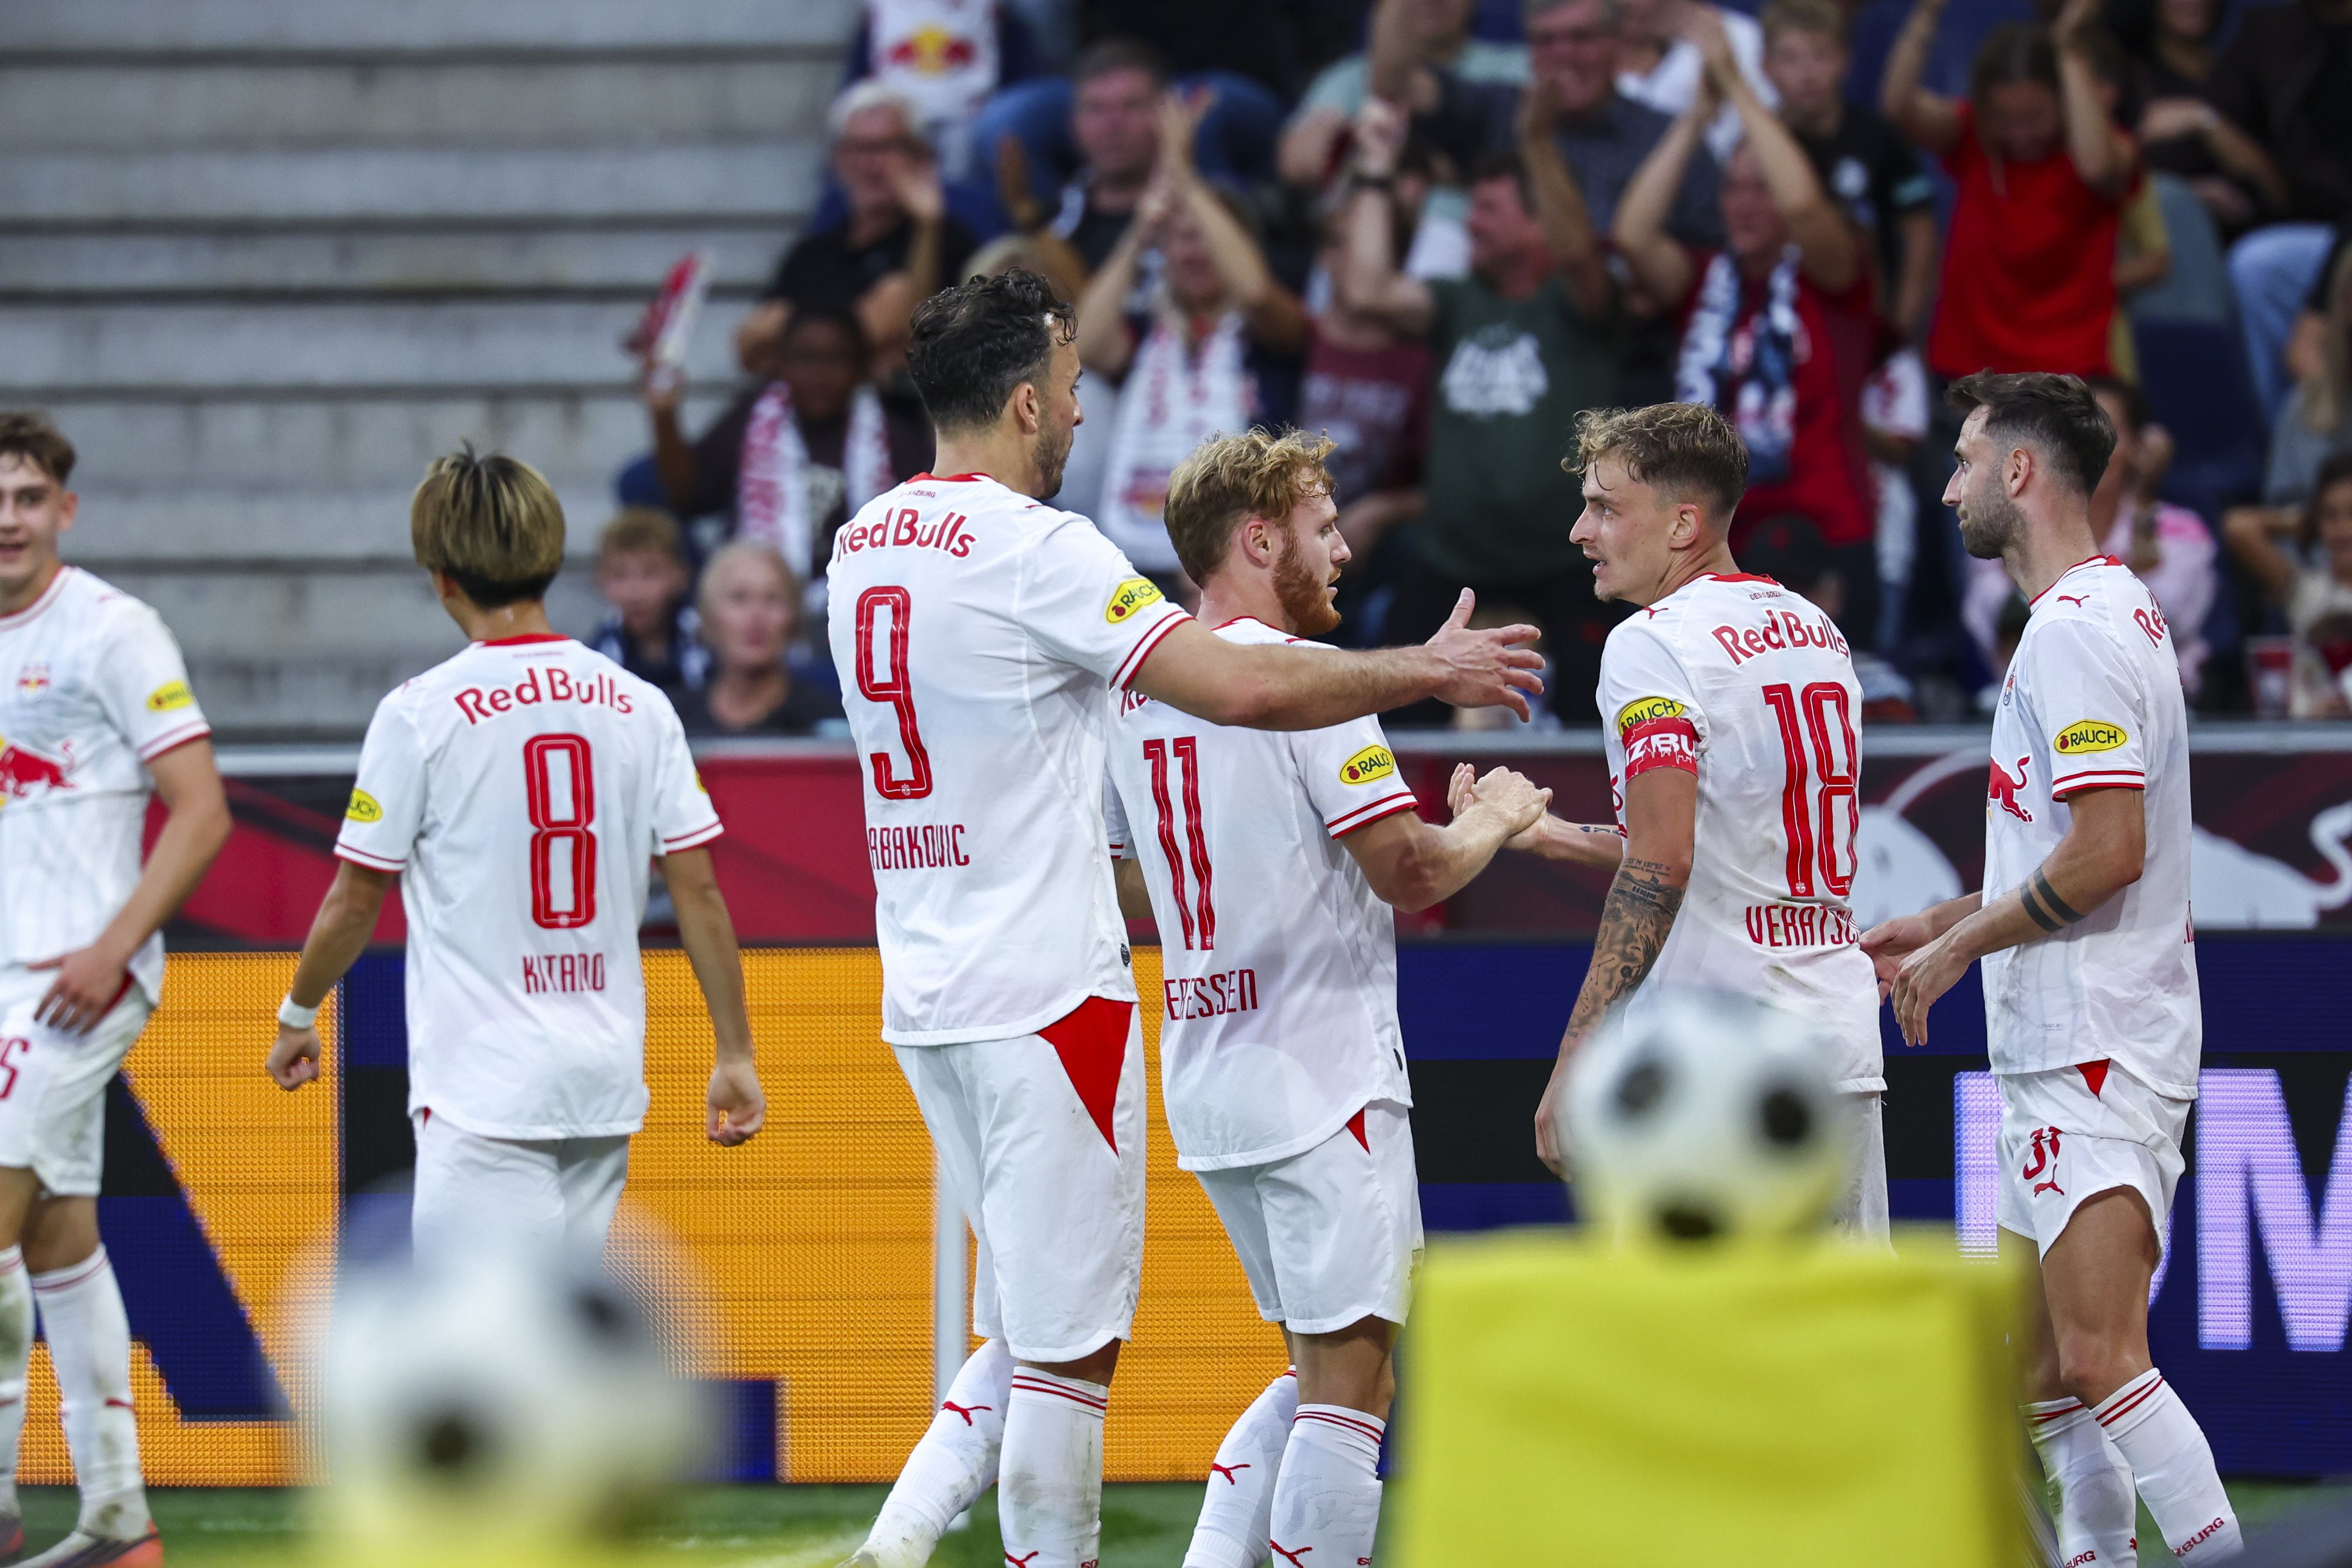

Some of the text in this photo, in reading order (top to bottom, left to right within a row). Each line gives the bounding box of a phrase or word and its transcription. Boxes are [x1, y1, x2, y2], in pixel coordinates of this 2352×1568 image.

[837, 507, 977, 564] Red Bulls
[1711, 609, 1849, 666] Red Bulls
[455, 668, 633, 725] Red Bulls
[856, 586, 933, 800] 9
[1626, 700, 1676, 727] RAUCH
[2070, 729, 2118, 747] RAUCH
[1762, 681, 1859, 897] 18
[523, 733, 597, 929] 8
[1143, 735, 1215, 951] 11
[523, 952, 604, 994] KITANO
